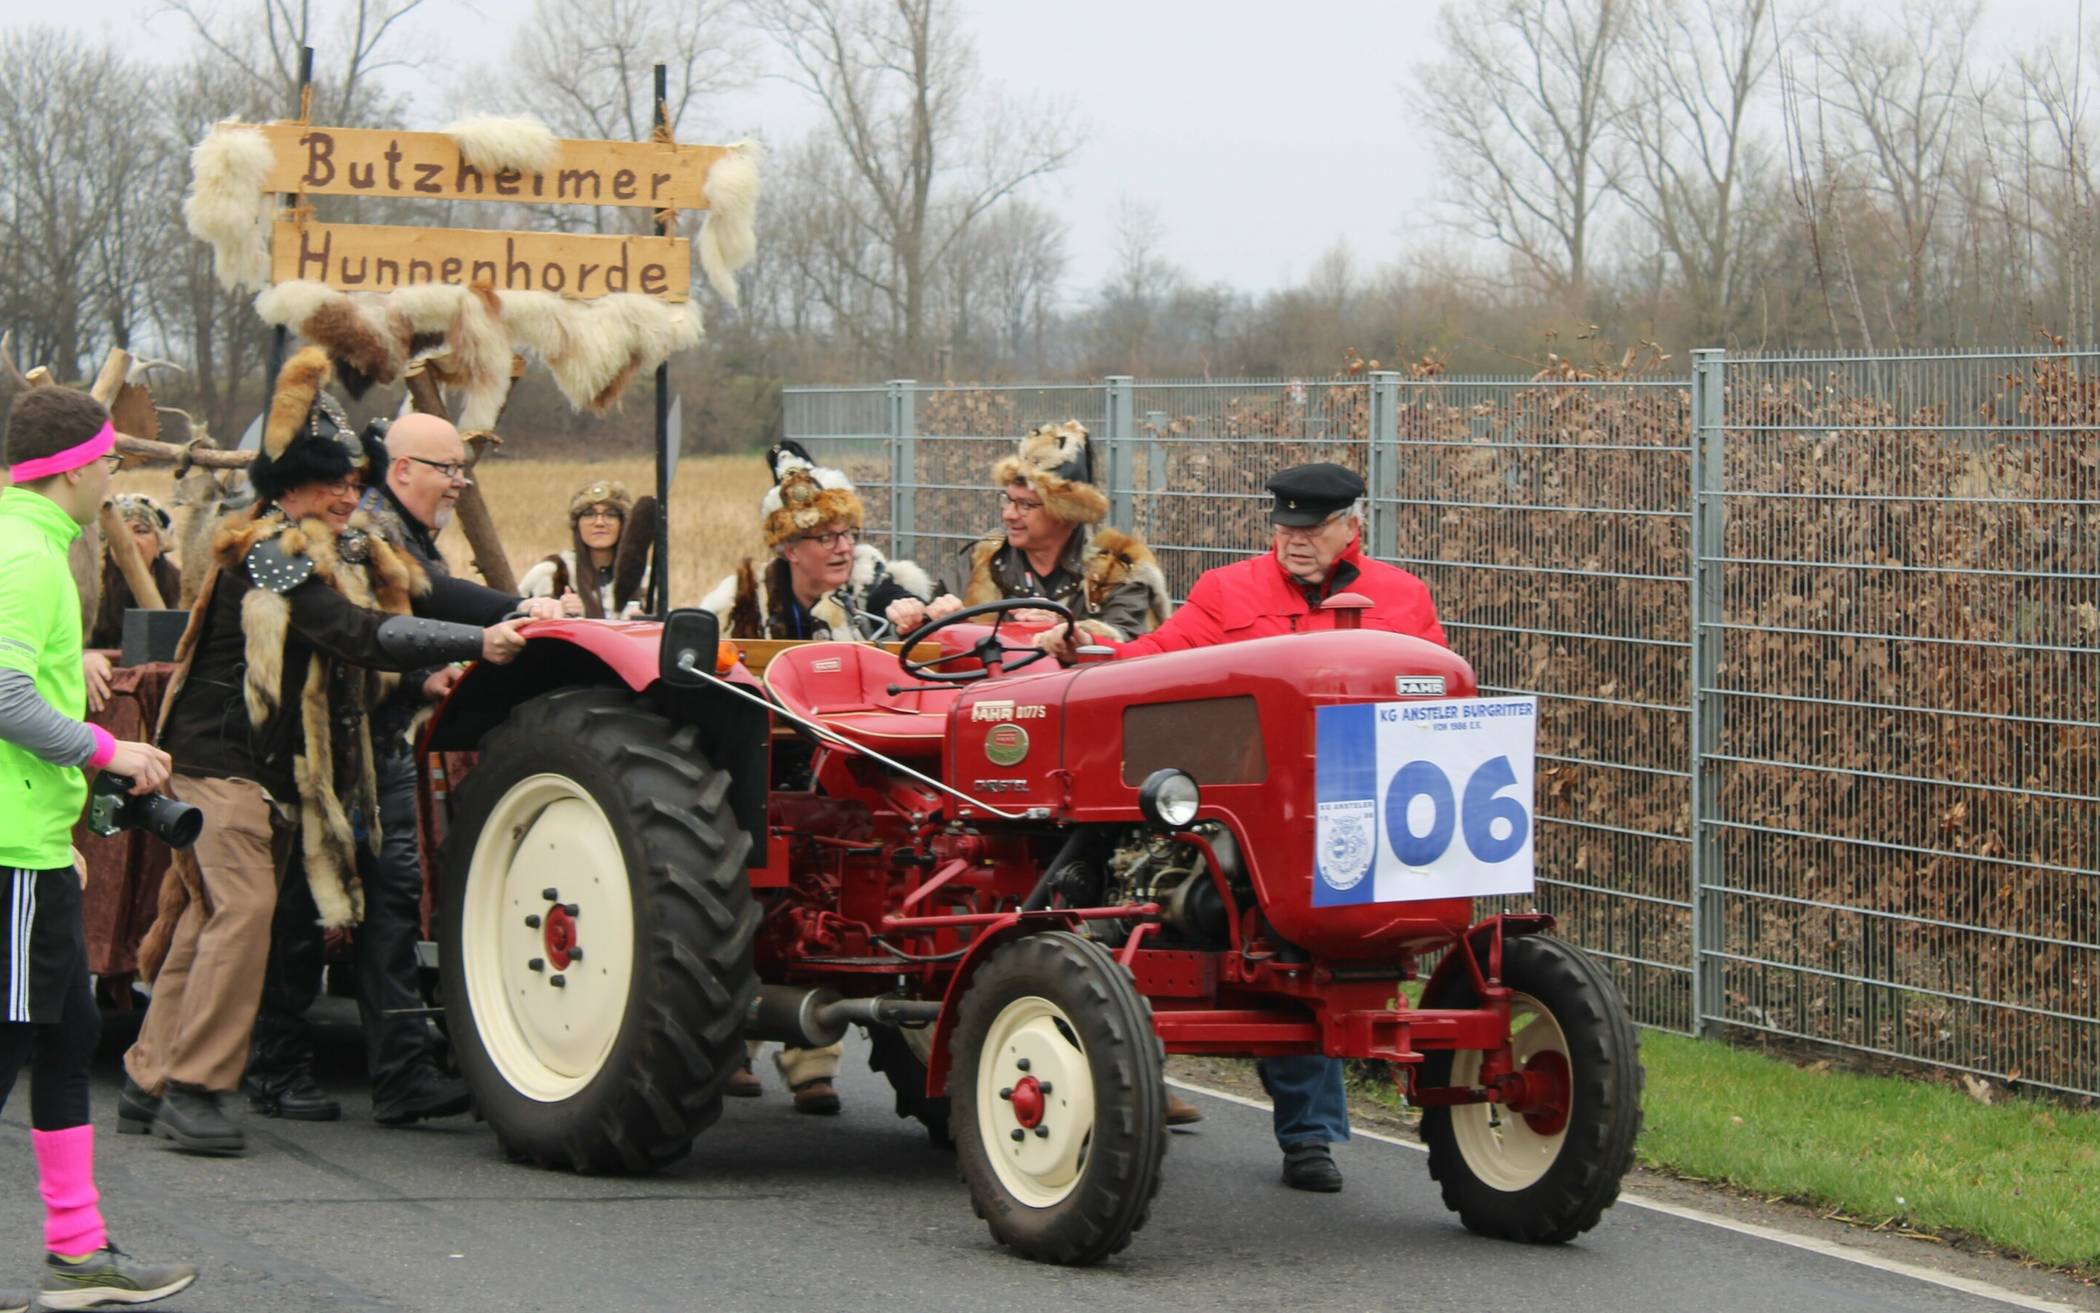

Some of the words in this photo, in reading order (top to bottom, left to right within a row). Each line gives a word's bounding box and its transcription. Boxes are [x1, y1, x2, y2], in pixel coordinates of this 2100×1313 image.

[299, 131, 672, 201] Butzheimer
[297, 230, 670, 295] Hunnenhorde
[1399, 679, 1443, 694] FAHR
[972, 700, 1014, 722] FAHR
[1380, 708, 1397, 722] KG
[1402, 706, 1458, 721] ANSTELER
[1463, 702, 1533, 718] BURGRITTER
[1385, 755, 1529, 867] 06
